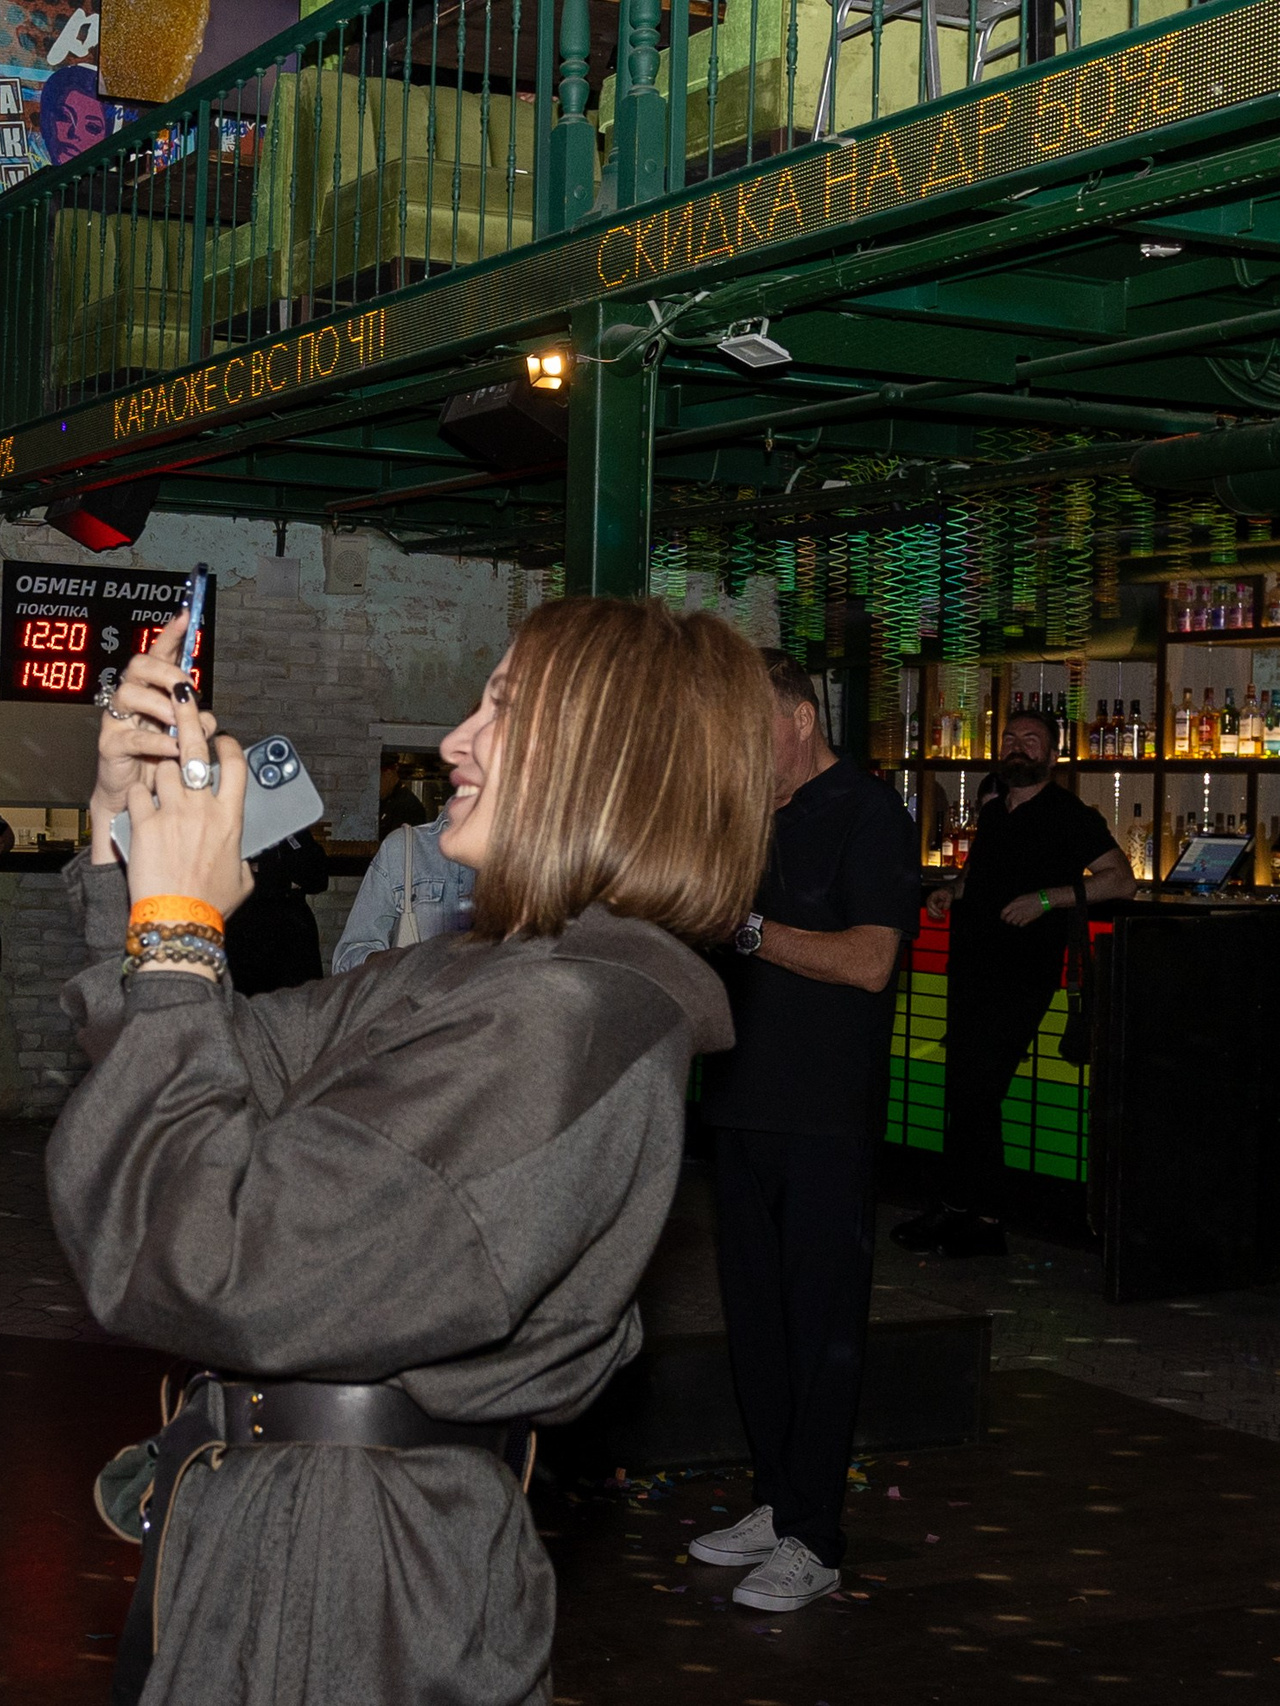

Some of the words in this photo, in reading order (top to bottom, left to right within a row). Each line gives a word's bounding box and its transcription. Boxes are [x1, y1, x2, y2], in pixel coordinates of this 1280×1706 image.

[597, 168, 803, 288] СКИДКА
[824, 132, 907, 219] НА
[920, 91, 1012, 198] ДР
[1033, 31, 1183, 151] 50%
[114, 366, 217, 440] КАРАОКЕ
[297, 325, 340, 384] ПО
[15, 574, 97, 599] ОБМЕН
[16, 602, 88, 619] ПОКУПКА
[23, 621, 88, 651] 12.20
[100, 625, 120, 654] $
